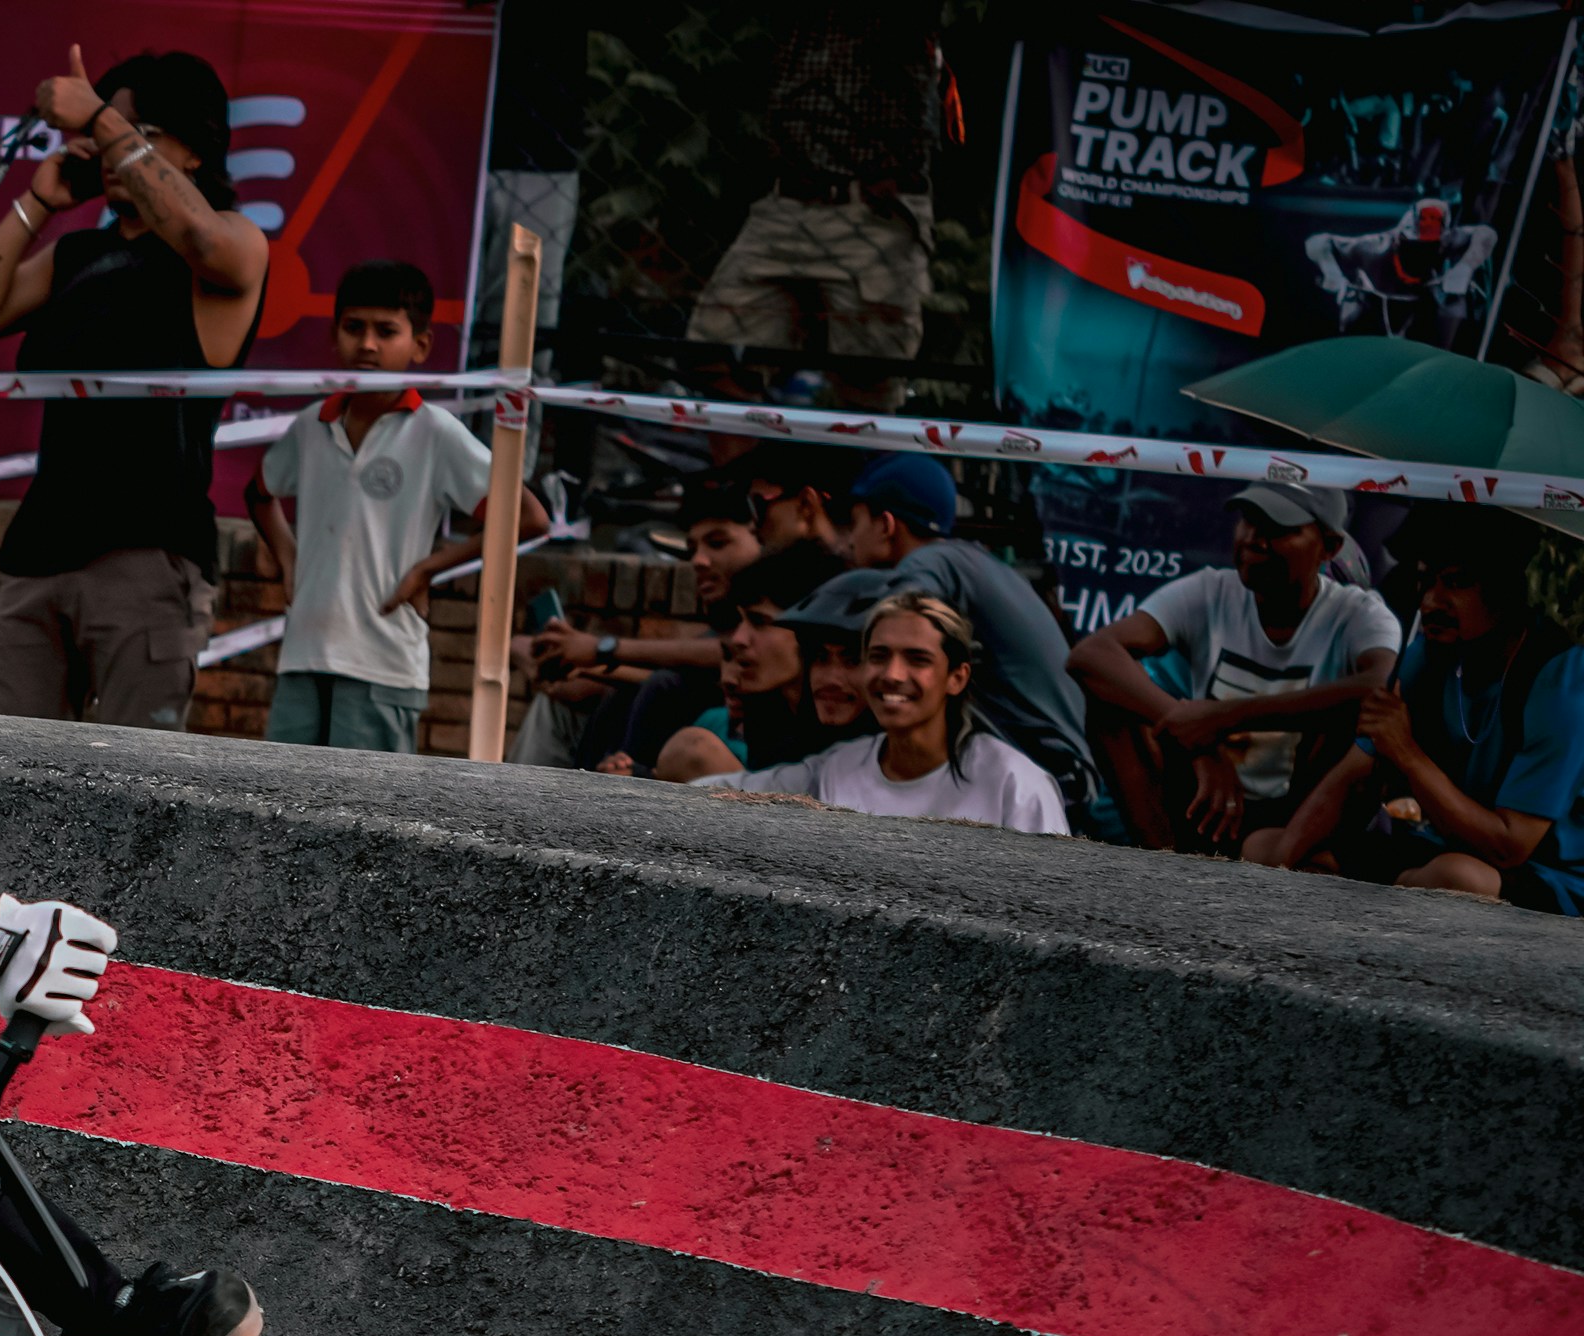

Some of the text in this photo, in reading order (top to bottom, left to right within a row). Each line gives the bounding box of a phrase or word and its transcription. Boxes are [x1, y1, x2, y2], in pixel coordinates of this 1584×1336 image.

[1091, 60, 1127, 77] UCI
[1072, 80, 1229, 137] PUMP
[1069, 123, 1257, 188] TRACK
[1062, 167, 1250, 206] WORLD CHAMPIONSHIPS
[1113, 546, 1184, 578] 2025
